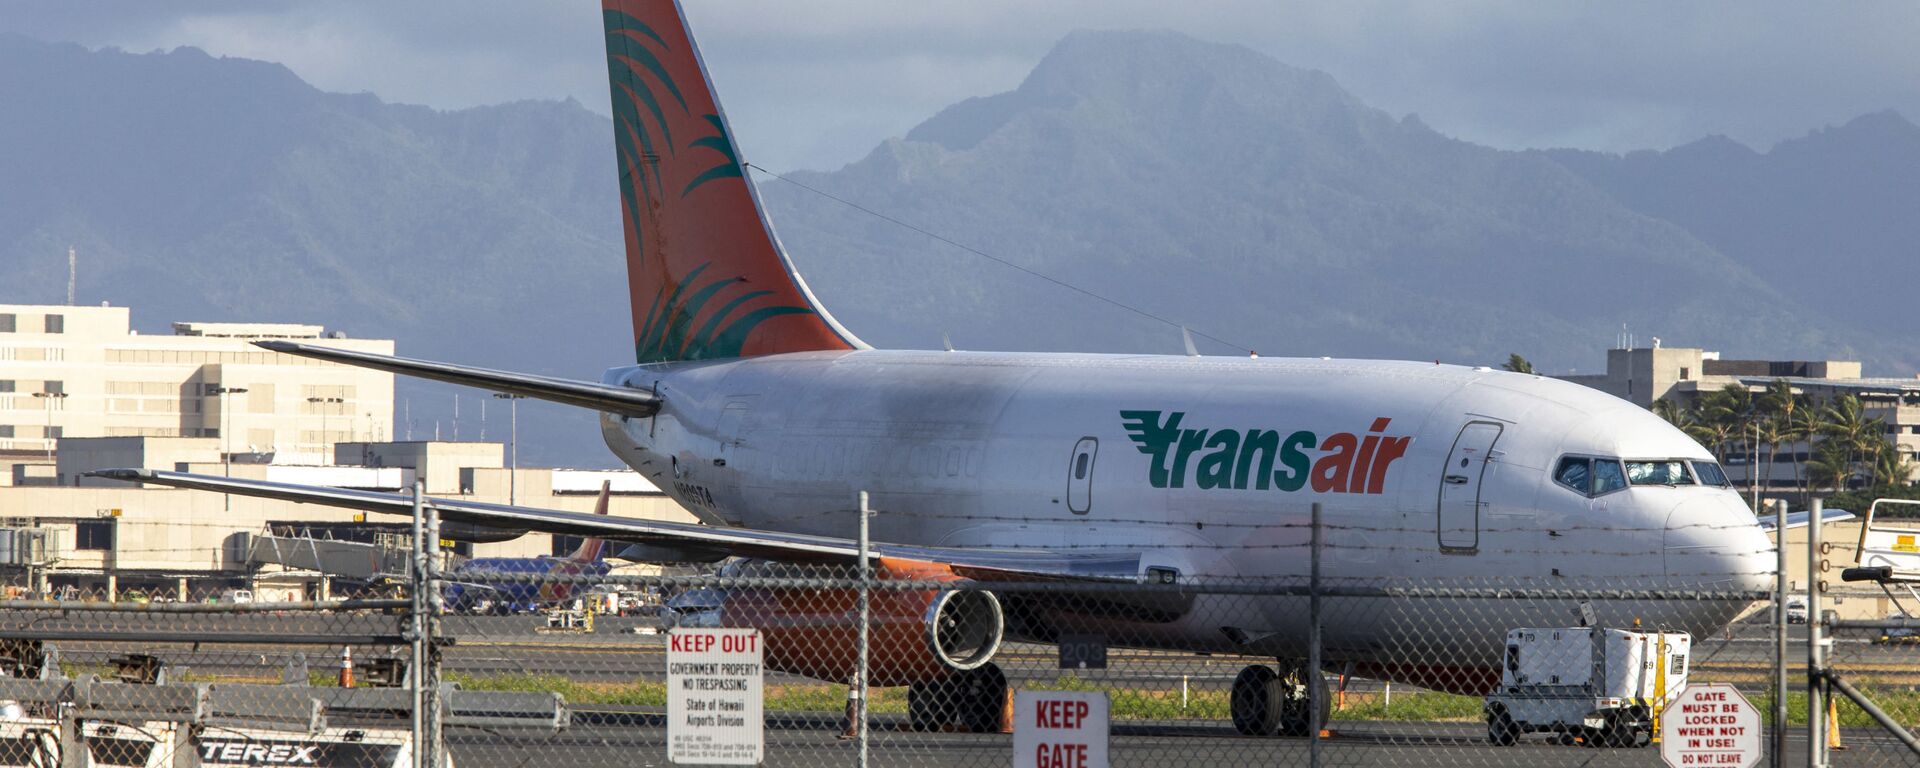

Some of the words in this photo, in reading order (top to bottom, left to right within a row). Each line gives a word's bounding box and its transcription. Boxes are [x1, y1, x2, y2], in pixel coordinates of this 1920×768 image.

[1119, 410, 1412, 494] transair
[671, 634, 715, 652] KEEP
[722, 634, 758, 653] OUT
[1063, 642, 1104, 661] 203
[670, 663, 718, 676] GOVERNMENT
[721, 663, 759, 676] PROPERTY
[683, 679, 693, 690] NO
[696, 679, 748, 691] TRESPASSING
[1694, 692, 1726, 701] GATE
[686, 698, 706, 711] State
[708, 698, 716, 711] of
[719, 698, 744, 711] Hawaii
[1682, 704, 1717, 713] MUST
[1723, 704, 1739, 713] BE
[686, 714, 715, 728] Airports
[717, 714, 744, 727] Division
[1036, 701, 1089, 729] KEEP
[1685, 716, 1736, 725] LOCKED
[1678, 727, 1715, 736] WHEN
[1720, 727, 1745, 736] NOT
[1688, 739, 1700, 748] IN
[1706, 739, 1735, 748] USE!
[201, 741, 318, 763] TEREX
[1036, 743, 1088, 768] GATE
[1682, 754, 1694, 764] DO
[1698, 754, 1713, 764] NOT
[1717, 754, 1742, 764] LEAVE
